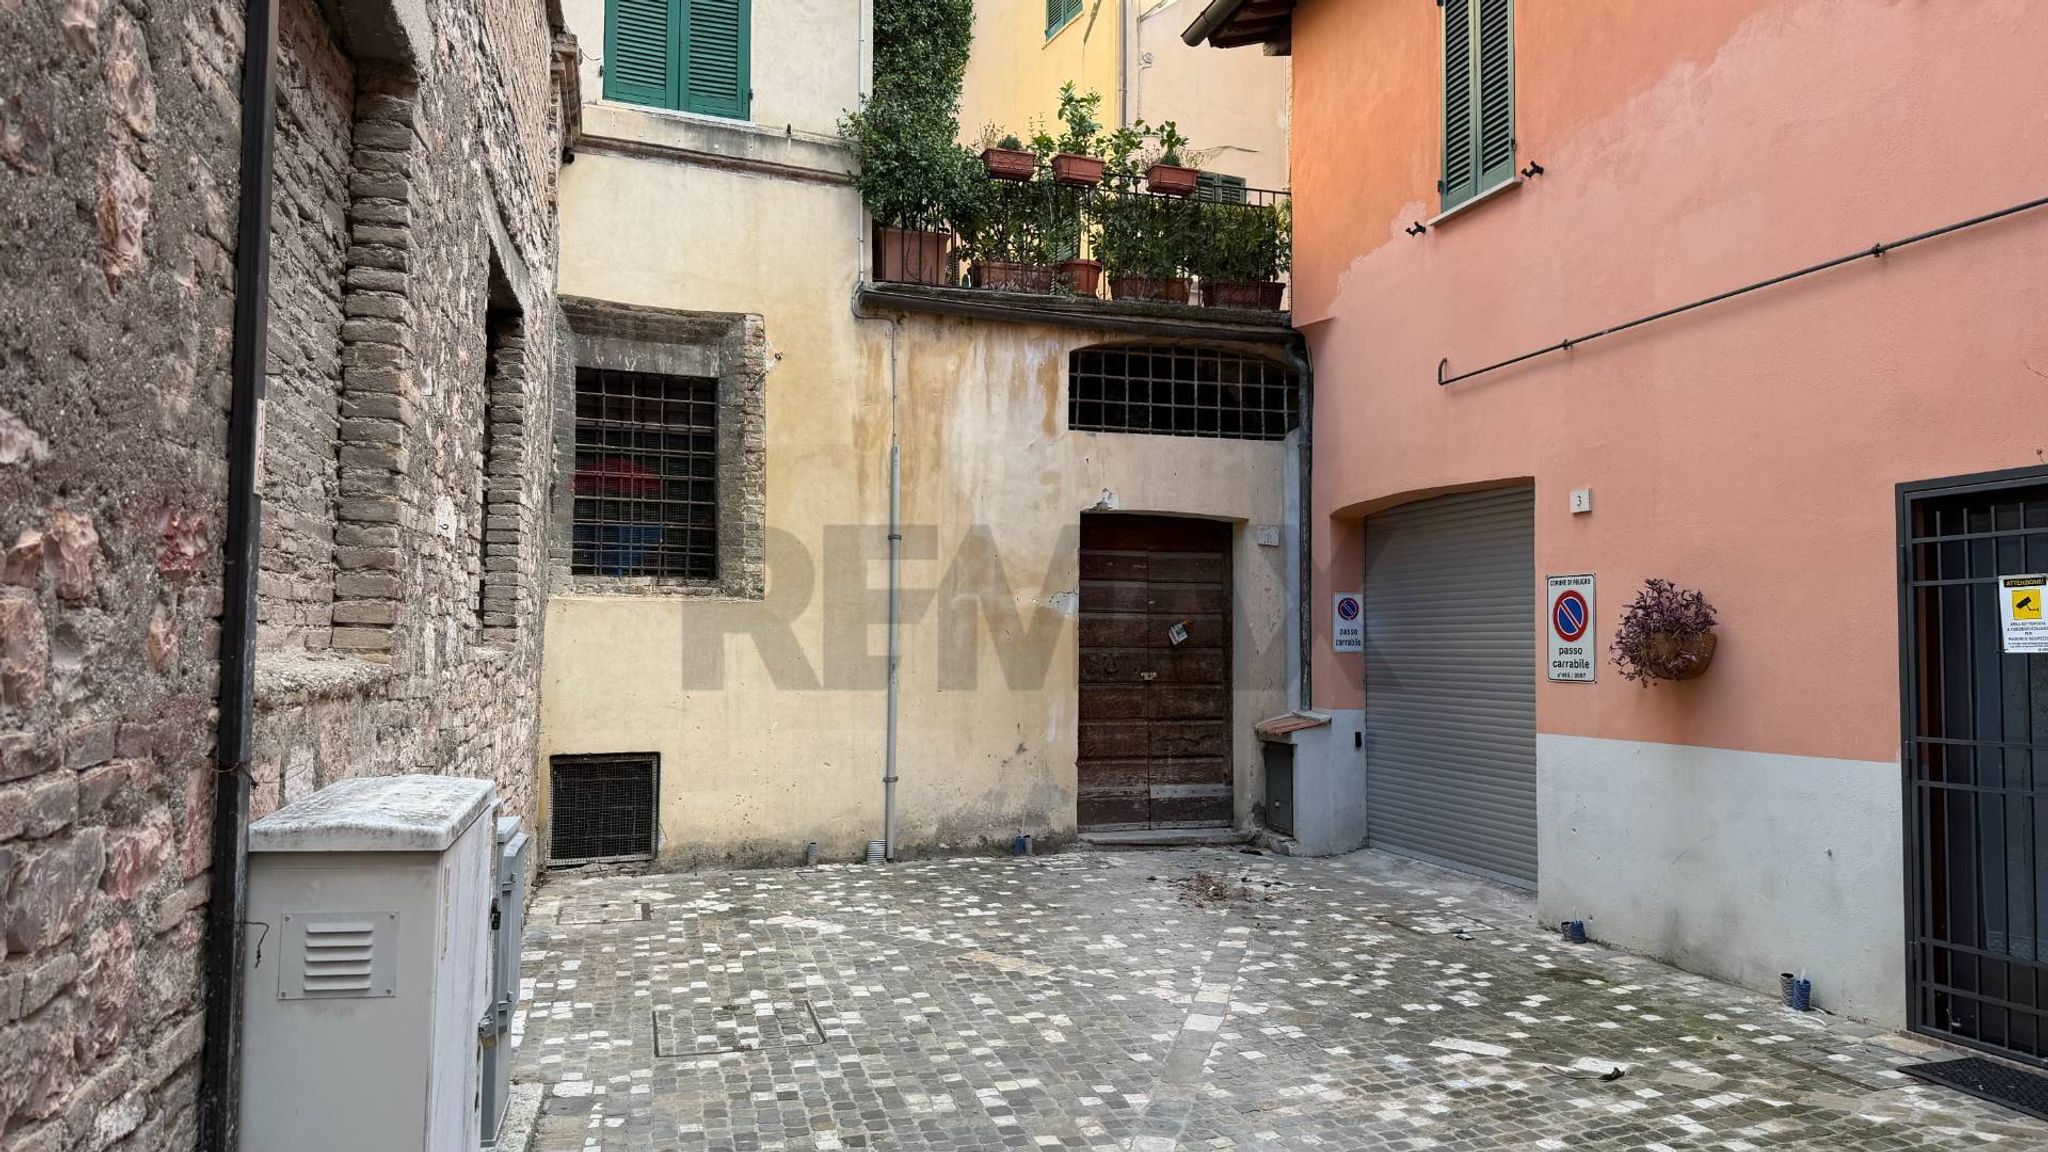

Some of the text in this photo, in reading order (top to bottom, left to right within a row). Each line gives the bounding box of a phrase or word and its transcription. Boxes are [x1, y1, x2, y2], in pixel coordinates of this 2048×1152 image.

[1577, 495, 1582, 506] 3
[1340, 628, 1358, 636] passo
[1336, 638, 1361, 646] carrabile
[1559, 647, 1583, 656] passo
[1552, 658, 1590, 669] carrabile
